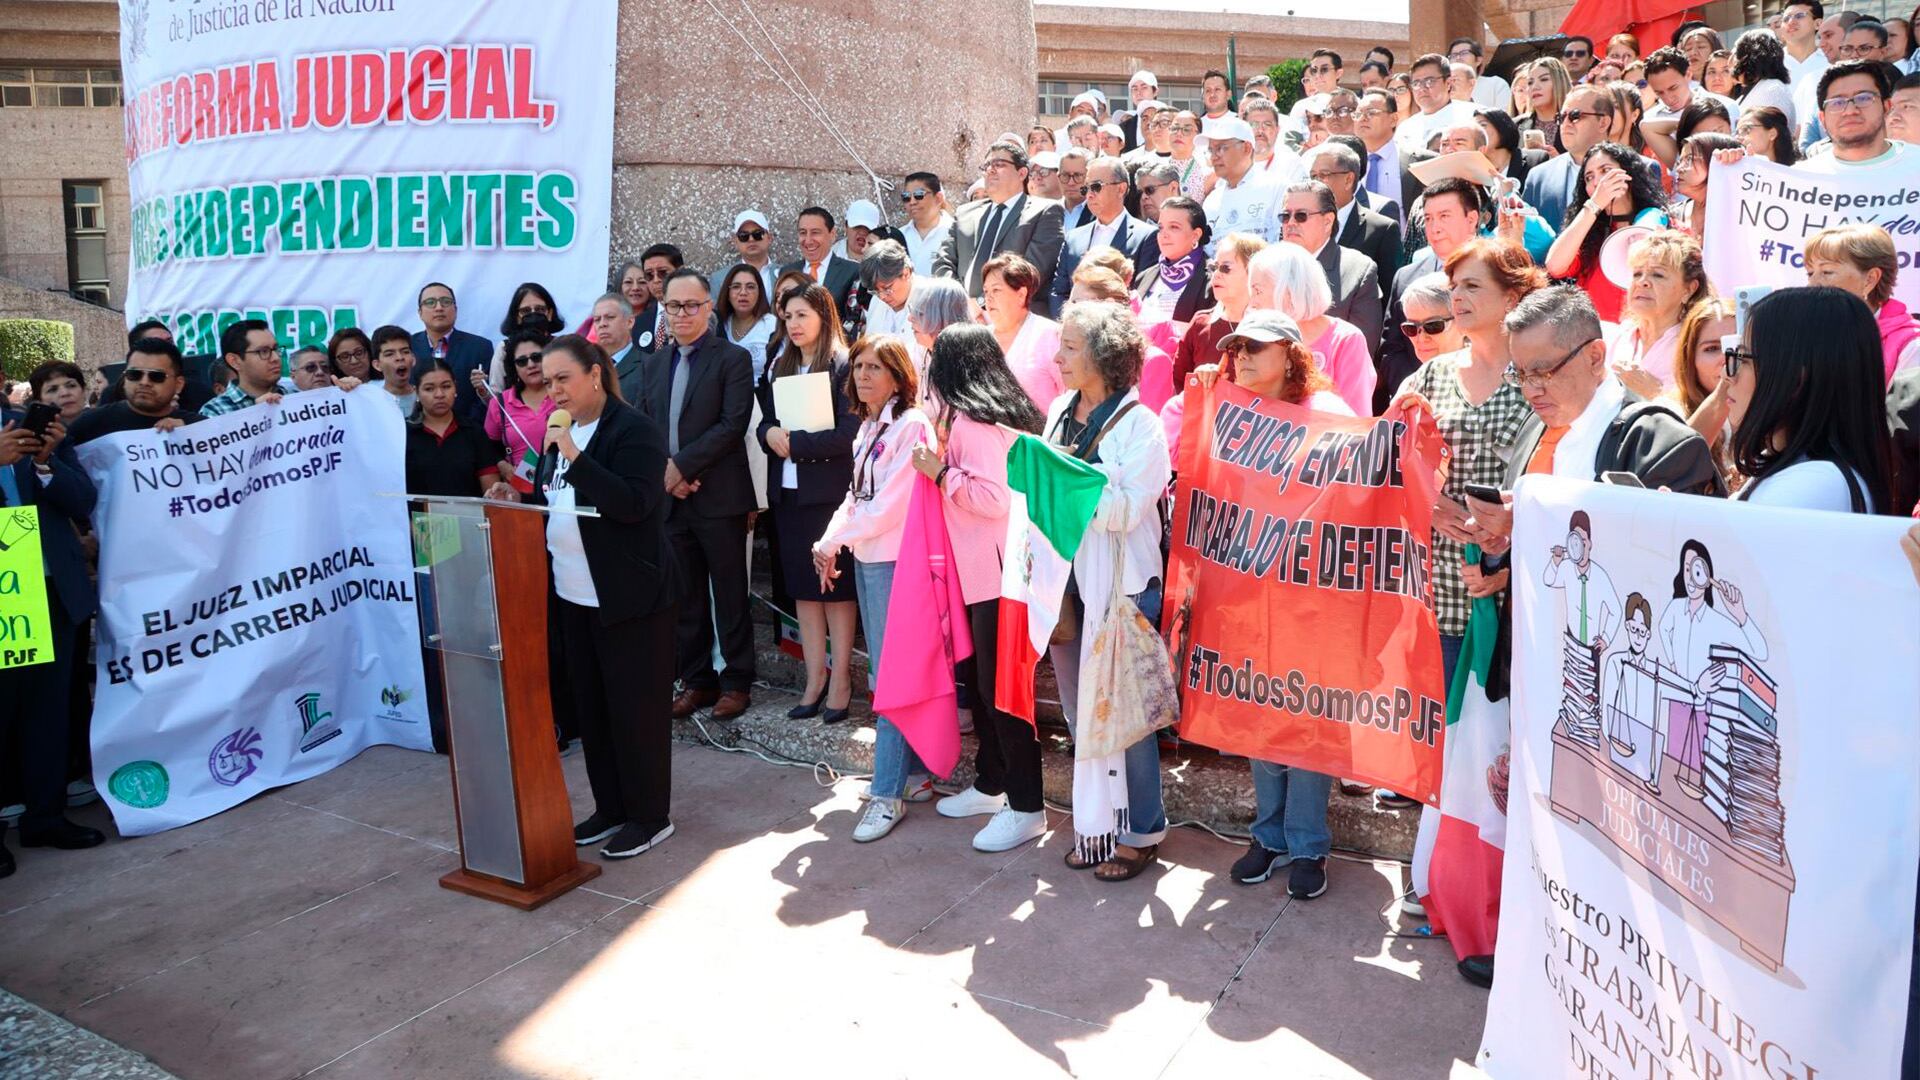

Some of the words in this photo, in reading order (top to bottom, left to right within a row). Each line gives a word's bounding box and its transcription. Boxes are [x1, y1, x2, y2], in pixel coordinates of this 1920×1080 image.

[168, 14, 185, 42] de
[186, 2, 250, 42] Justicia
[254, 0, 278, 24] de
[283, 0, 303, 20] la
[138, 60, 283, 157] REFORMA
[290, 46, 556, 129] JUDICIAL,
[172, 173, 576, 260] INDEPENDIENTES
[1739, 199, 1789, 231] NO
[1741, 172, 1772, 195] Sin
[126, 444, 159, 462] Sin
[278, 399, 347, 426] Judicial
[132, 463, 183, 493] NO
[192, 449, 245, 485] HAY
[248, 424, 345, 470] democracia
[1211, 398, 1307, 494] MÉXICO,
[106, 655, 134, 685] ES
[142, 642, 185, 674] DE
[190, 597, 327, 658] CARRERA
[329, 578, 414, 613] JUDICIAL
[142, 608, 178, 637] EL
[184, 585, 248, 626] JUEZ
[252, 546, 375, 600] IMPARCIAL
[4, 648, 38, 666] PJF
[1188, 645, 1445, 748] #TodosSomosPJF
[1599, 800, 1714, 904] JUDICIALES
[1605, 777, 1710, 867] OFICIALES
[1559, 926, 1723, 1080] TRABAJAR
